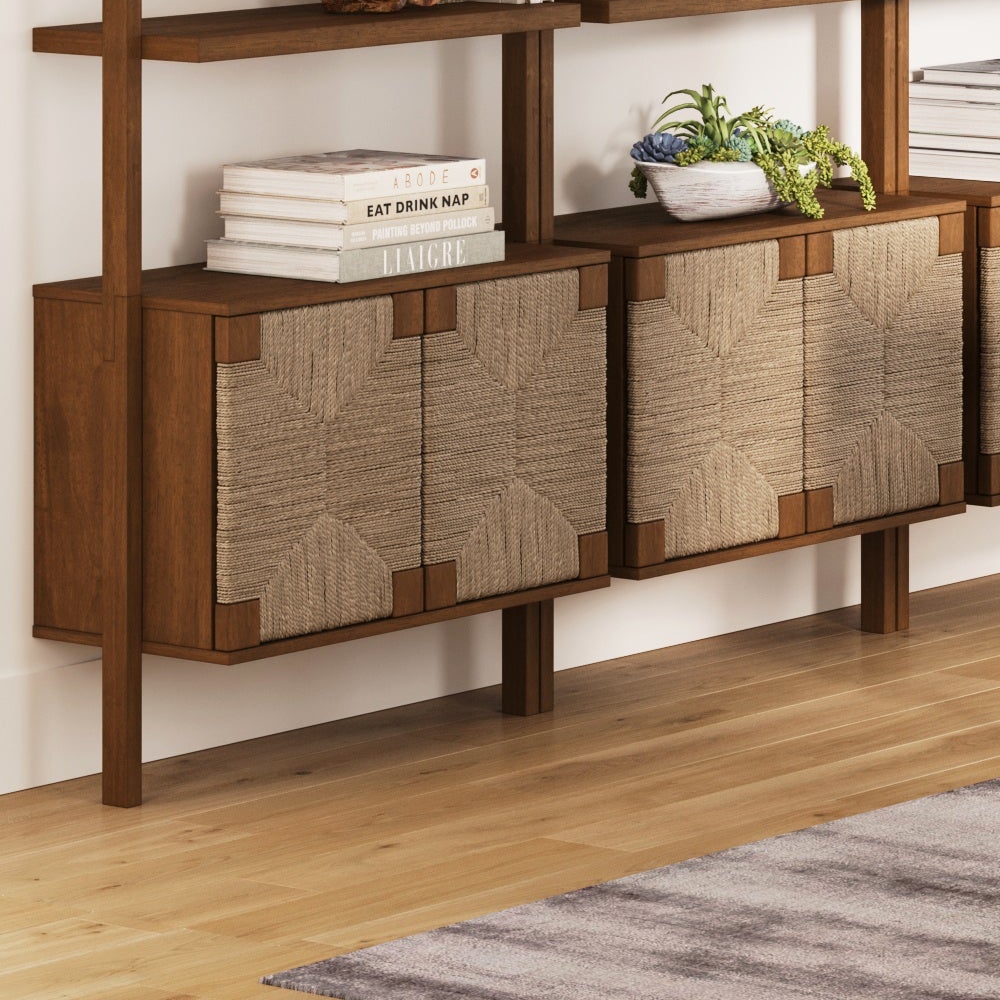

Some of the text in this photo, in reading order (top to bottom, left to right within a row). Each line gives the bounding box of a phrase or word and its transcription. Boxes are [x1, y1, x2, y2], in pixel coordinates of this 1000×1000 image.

[393, 169, 449, 190] ABODE
[367, 202, 392, 217] EAT
[395, 197, 438, 214] DRINK
[441, 193, 470, 209] NAP
[372, 225, 408, 241] PAINTING
[410, 220, 441, 237] BEYOND
[442, 215, 478, 233] POLLOCK
[383, 239, 466, 275] LIAIGRE
